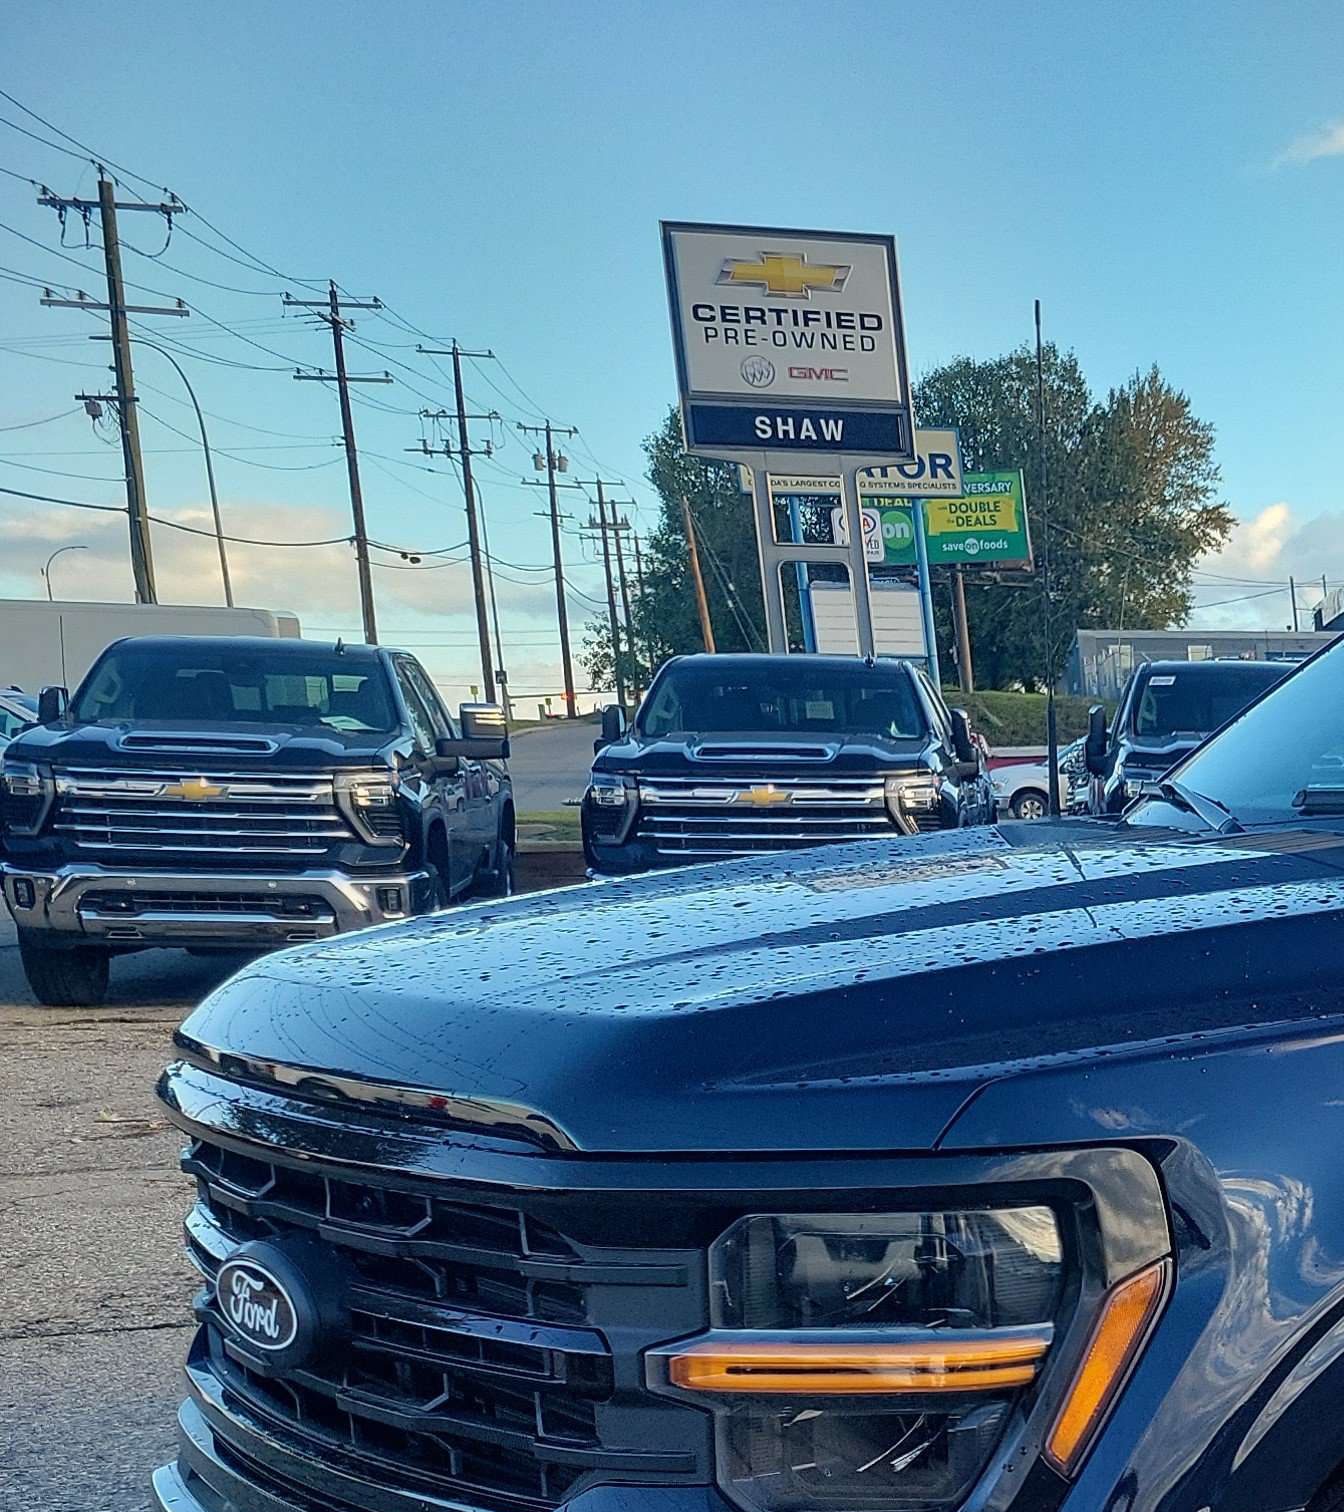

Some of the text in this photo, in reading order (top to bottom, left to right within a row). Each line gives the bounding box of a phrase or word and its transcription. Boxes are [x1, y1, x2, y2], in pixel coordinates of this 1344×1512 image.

[692, 303, 884, 331] CERTIFIED
[704, 326, 876, 352] PRE-OWNED
[788, 366, 849, 382] GMC
[754, 416, 845, 442] SHAW
[790, 481, 827, 489] LARGEST
[868, 482, 907, 490] SYSTEMS
[907, 482, 957, 491] SPECIALISTS
[964, 480, 1013, 495] VERSARY
[949, 501, 1002, 515] DOUBLE
[955, 515, 997, 527] DEALS
[882, 523, 910, 539] on
[230, 1270, 280, 1339] Ford
